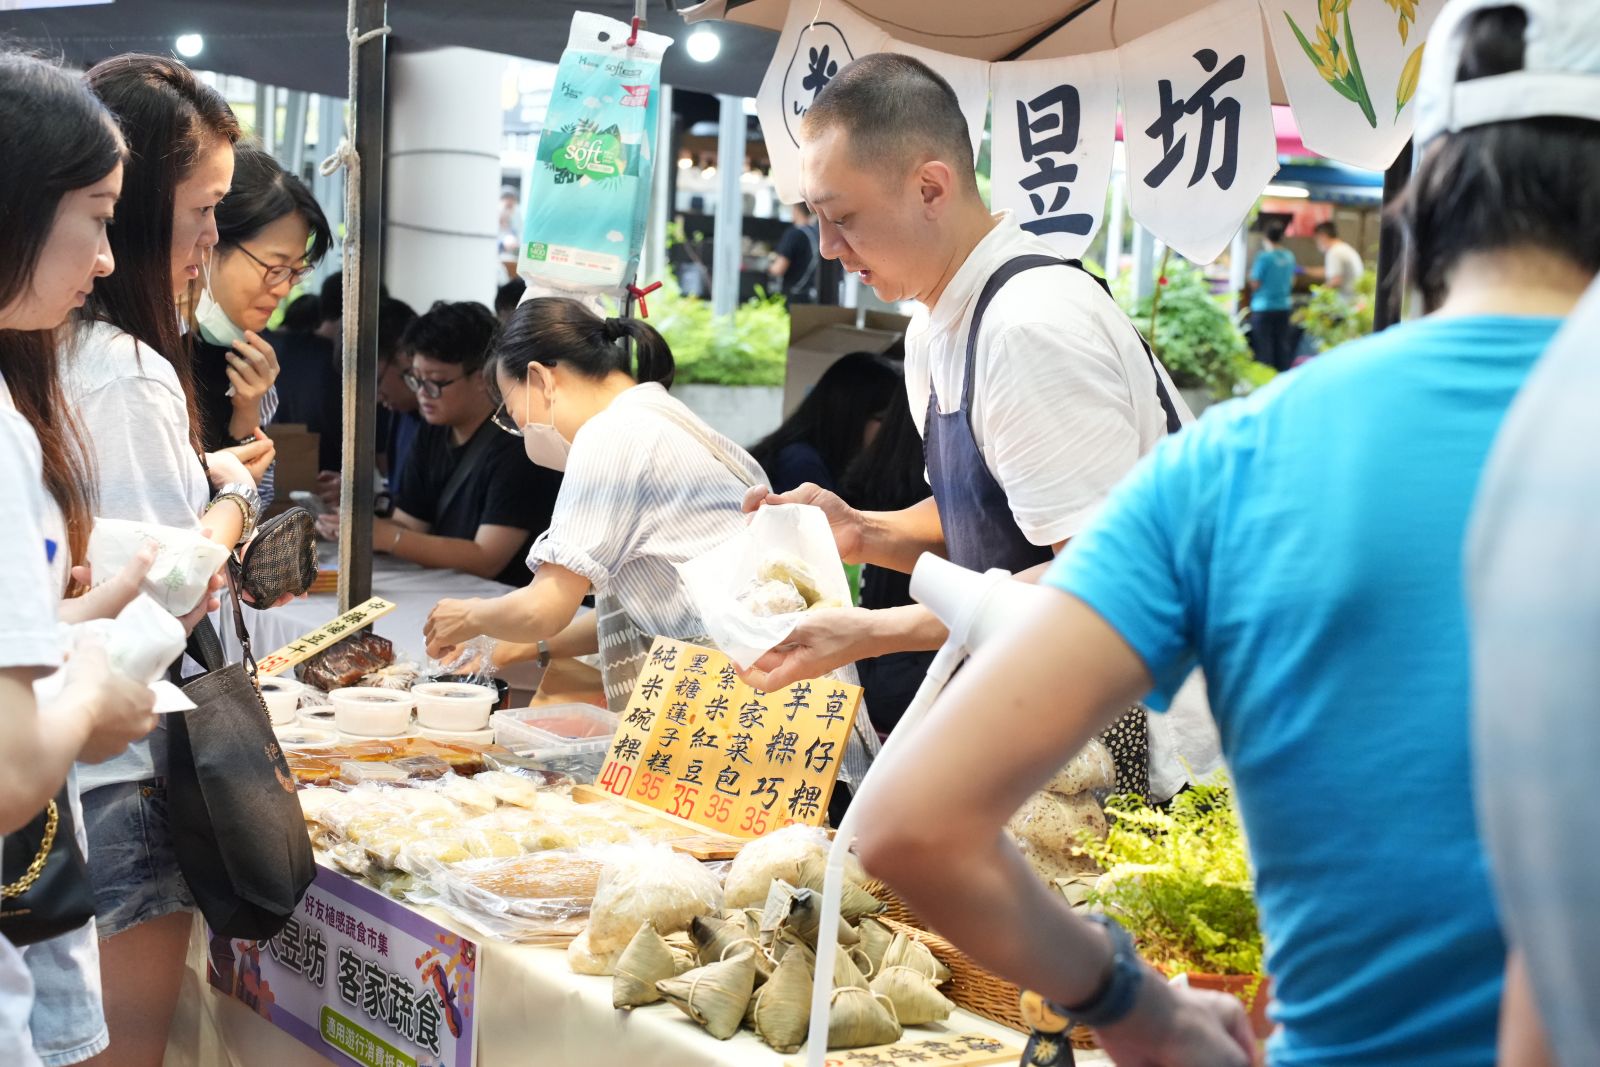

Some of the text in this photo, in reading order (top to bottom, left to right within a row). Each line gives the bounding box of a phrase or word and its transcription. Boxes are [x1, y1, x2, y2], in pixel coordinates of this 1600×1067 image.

[564, 139, 603, 170] soft
[600, 644, 678, 797] 純米碗粿 40
[636, 654, 709, 801] 黑糖蓮子糕 35
[677, 662, 737, 787] 紫米紅豆
[714, 688, 769, 797] 家菜包
[750, 681, 812, 811] 芋粿巧
[788, 689, 848, 820] 草仔粿
[665, 783, 699, 821] 35
[704, 794, 734, 824] 35
[740, 806, 770, 836] 35
[305, 893, 389, 958] 好友植感蔬食市集
[338, 948, 440, 1056] 客家蔬食
